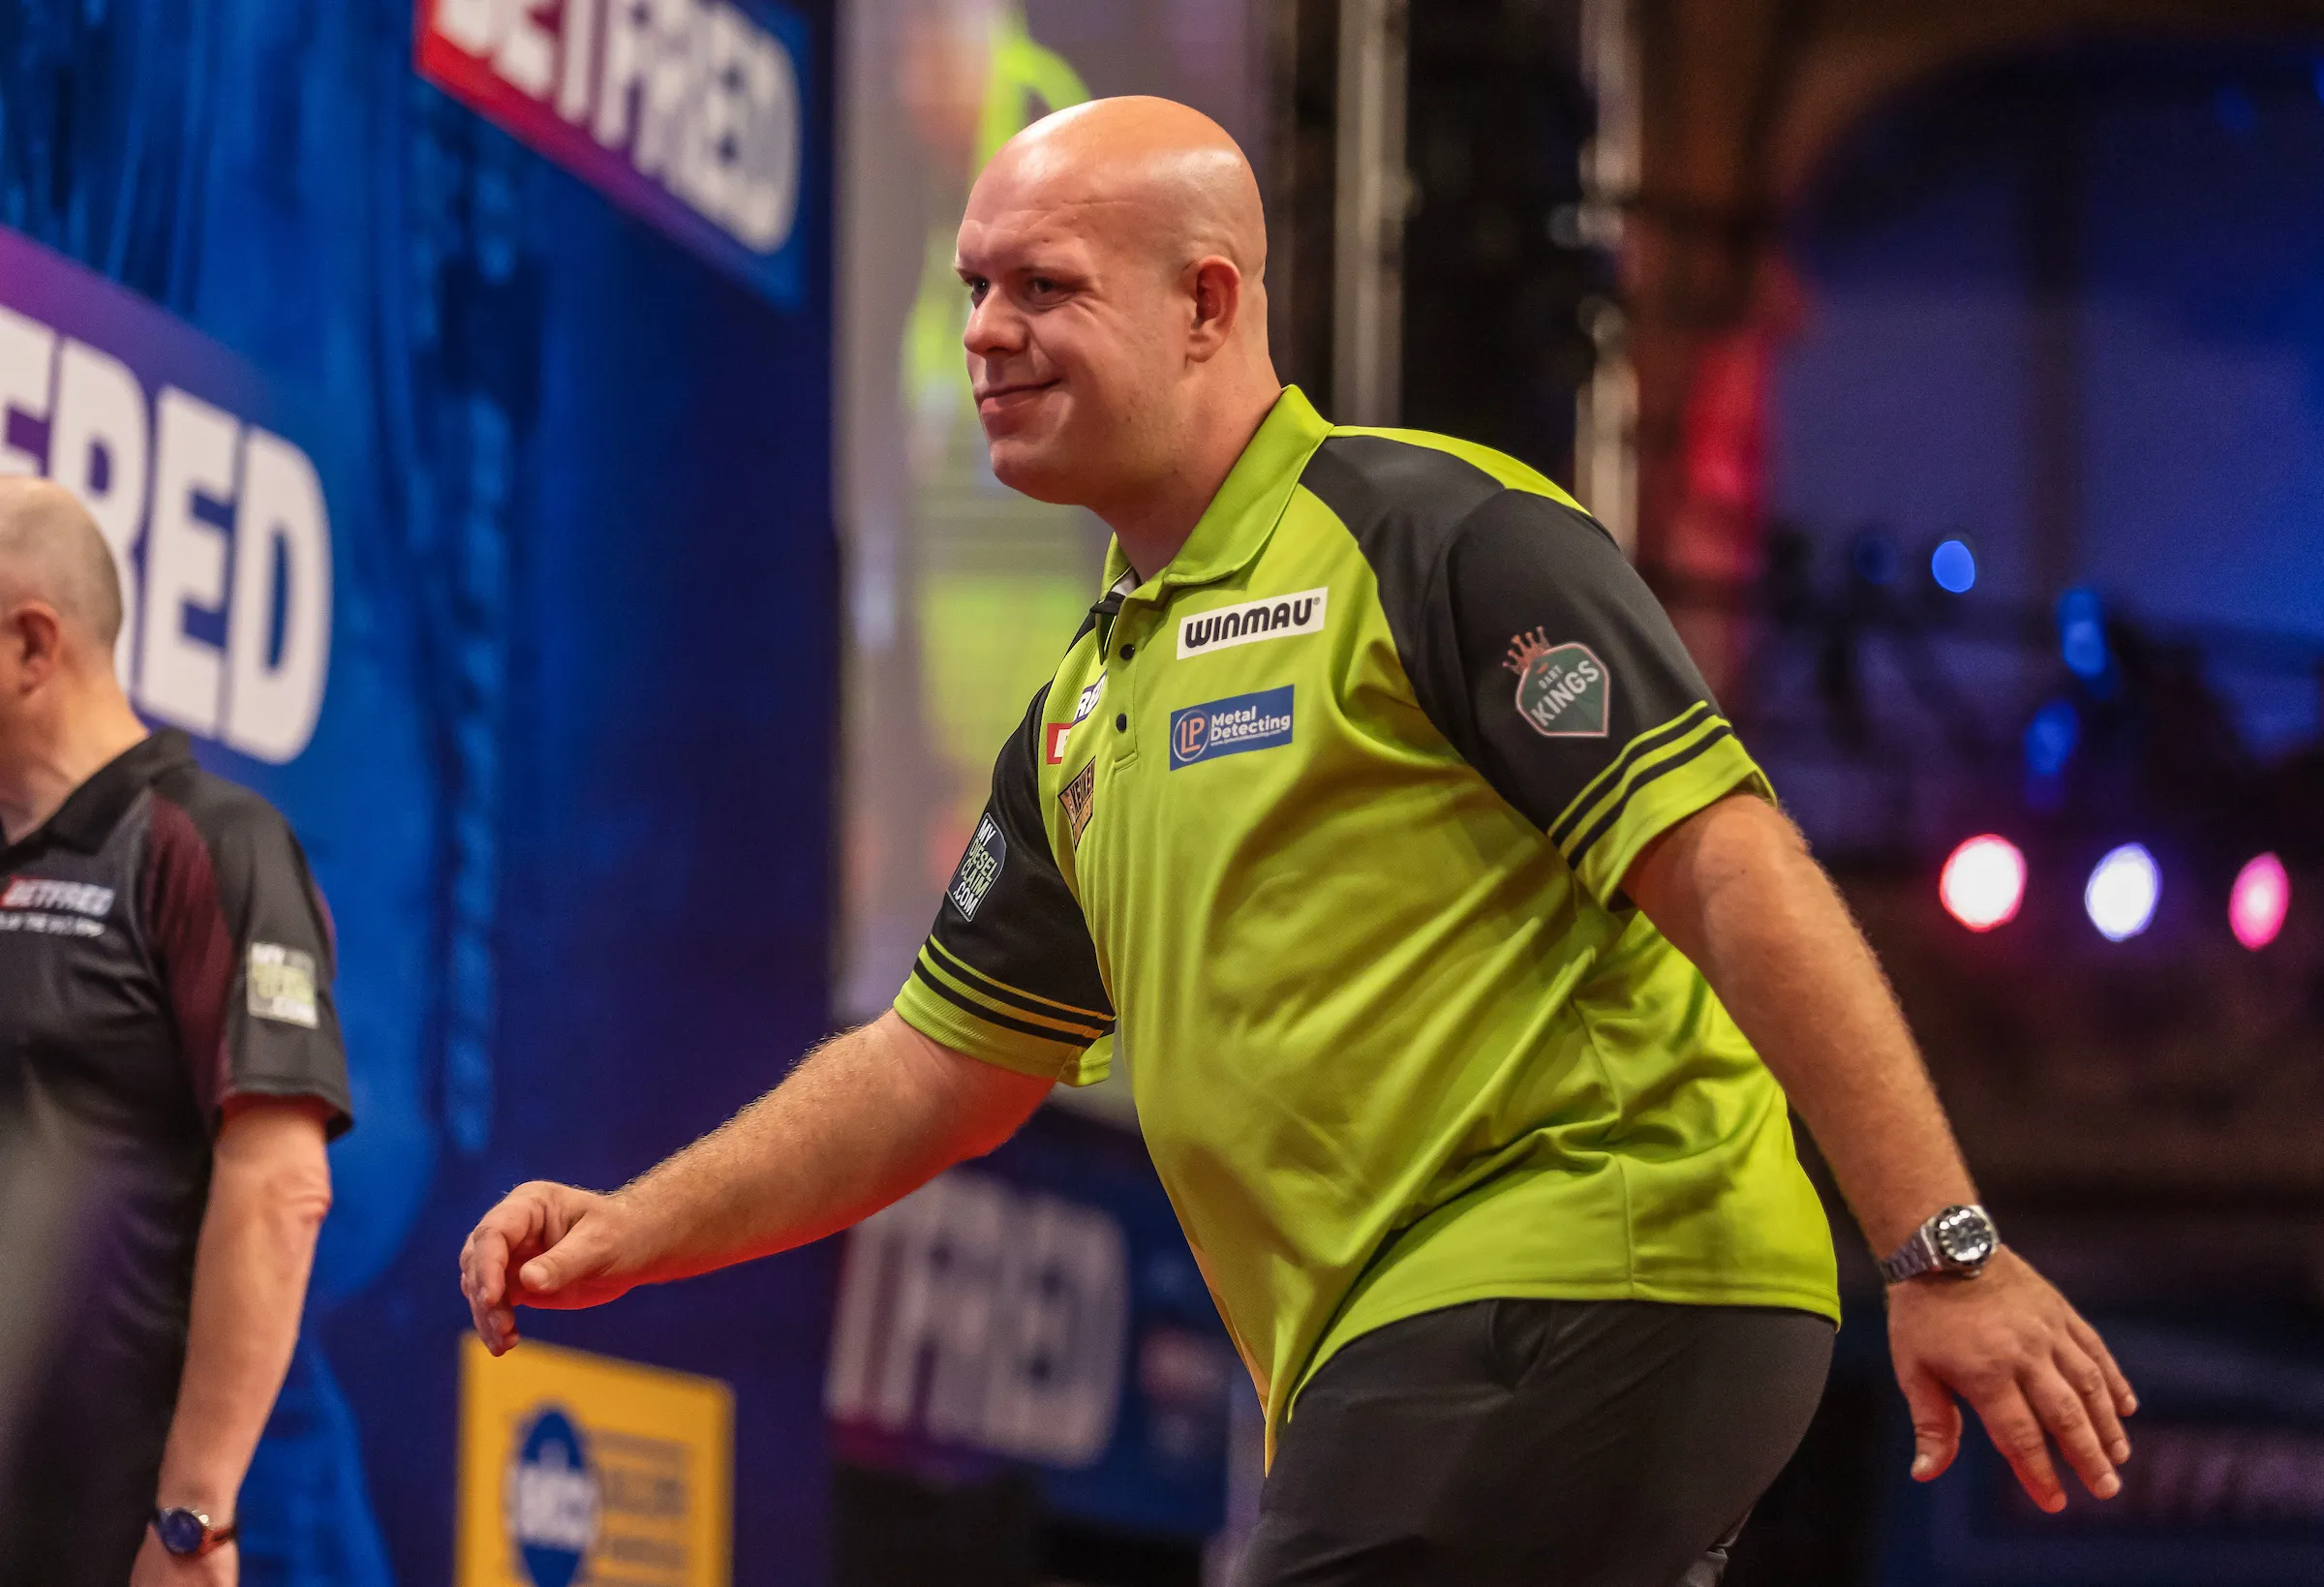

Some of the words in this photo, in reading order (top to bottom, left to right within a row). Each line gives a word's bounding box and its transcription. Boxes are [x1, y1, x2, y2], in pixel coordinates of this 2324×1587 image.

[433, 0, 800, 254] FRED
[1185, 597, 1313, 649] WINMAU
[1531, 660, 1600, 727] KINGS
[1180, 717, 1206, 753] LP
[1210, 715, 1291, 742] Detecting
[1211, 705, 1257, 727] Metal
[976, 817, 996, 846] MY
[961, 858, 990, 899] CLAIM
[969, 838, 998, 882] DIESEL
[953, 881, 979, 916] .COM
